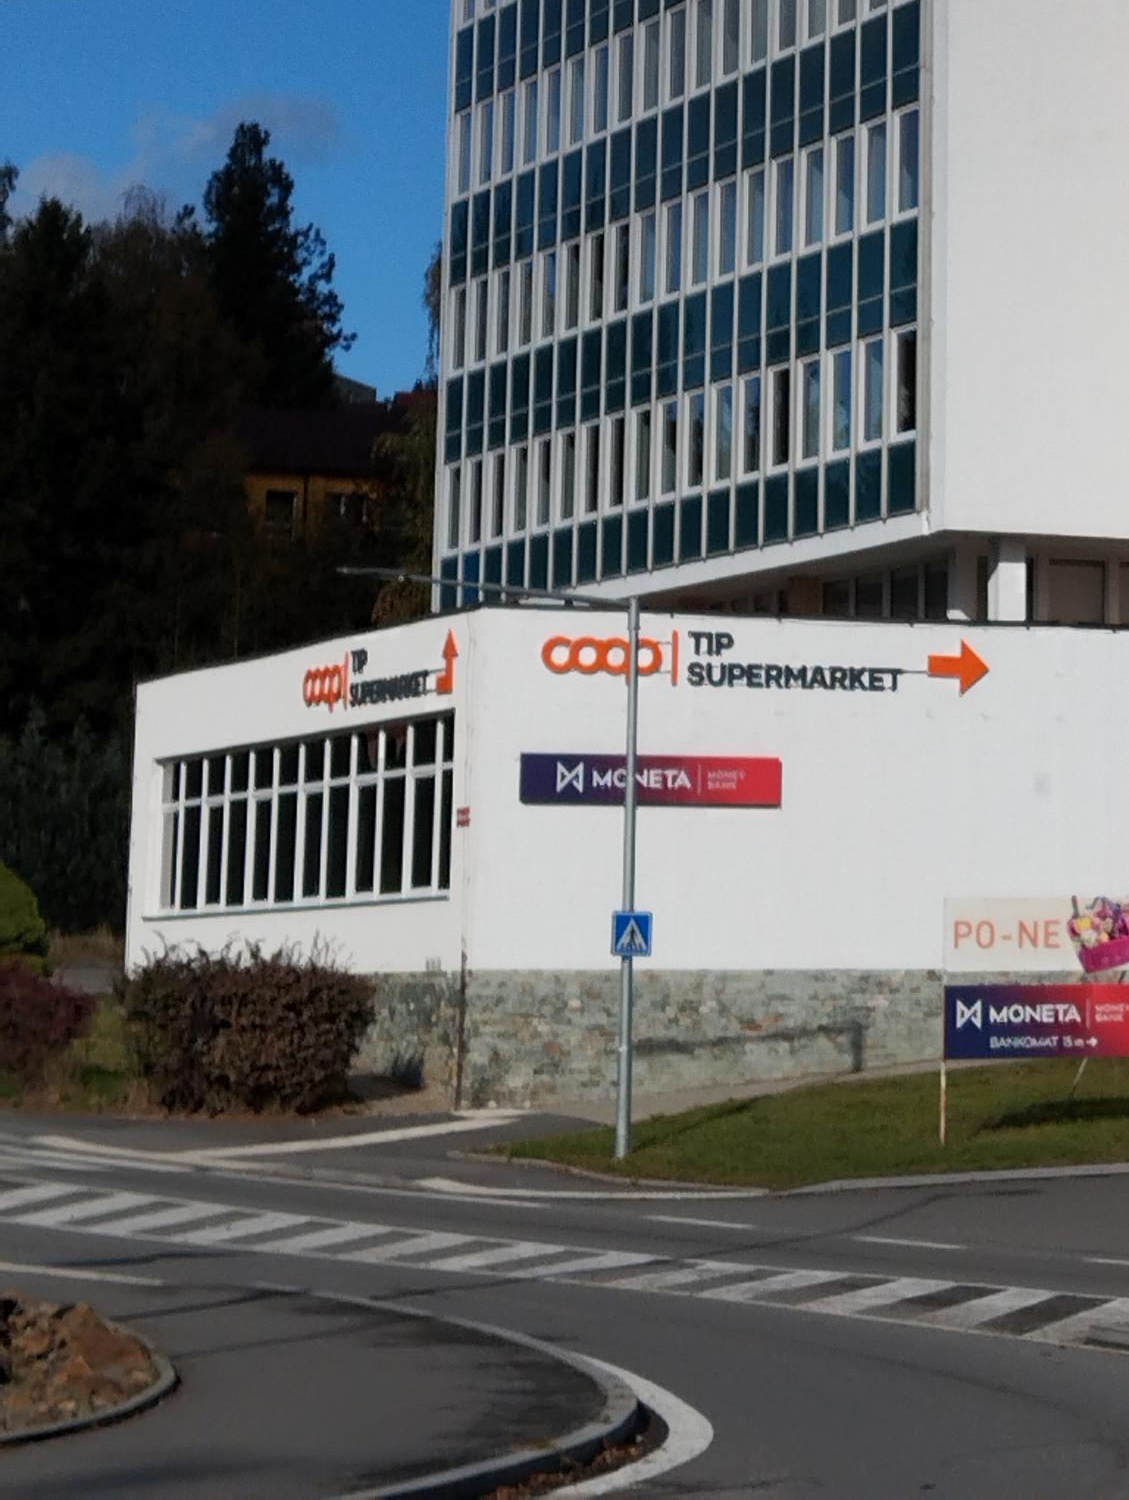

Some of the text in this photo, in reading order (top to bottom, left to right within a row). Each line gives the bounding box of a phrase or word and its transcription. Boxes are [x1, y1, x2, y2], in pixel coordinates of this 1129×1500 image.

[688, 630, 735, 656] TIP
[350, 647, 369, 675] TIP
[350, 668, 429, 708] SUPERMARKET
[687, 662, 903, 692] SUPERMARKET
[989, 1003, 1081, 1024] MONETA
[989, 1036, 1059, 1049] BANKOMAT
